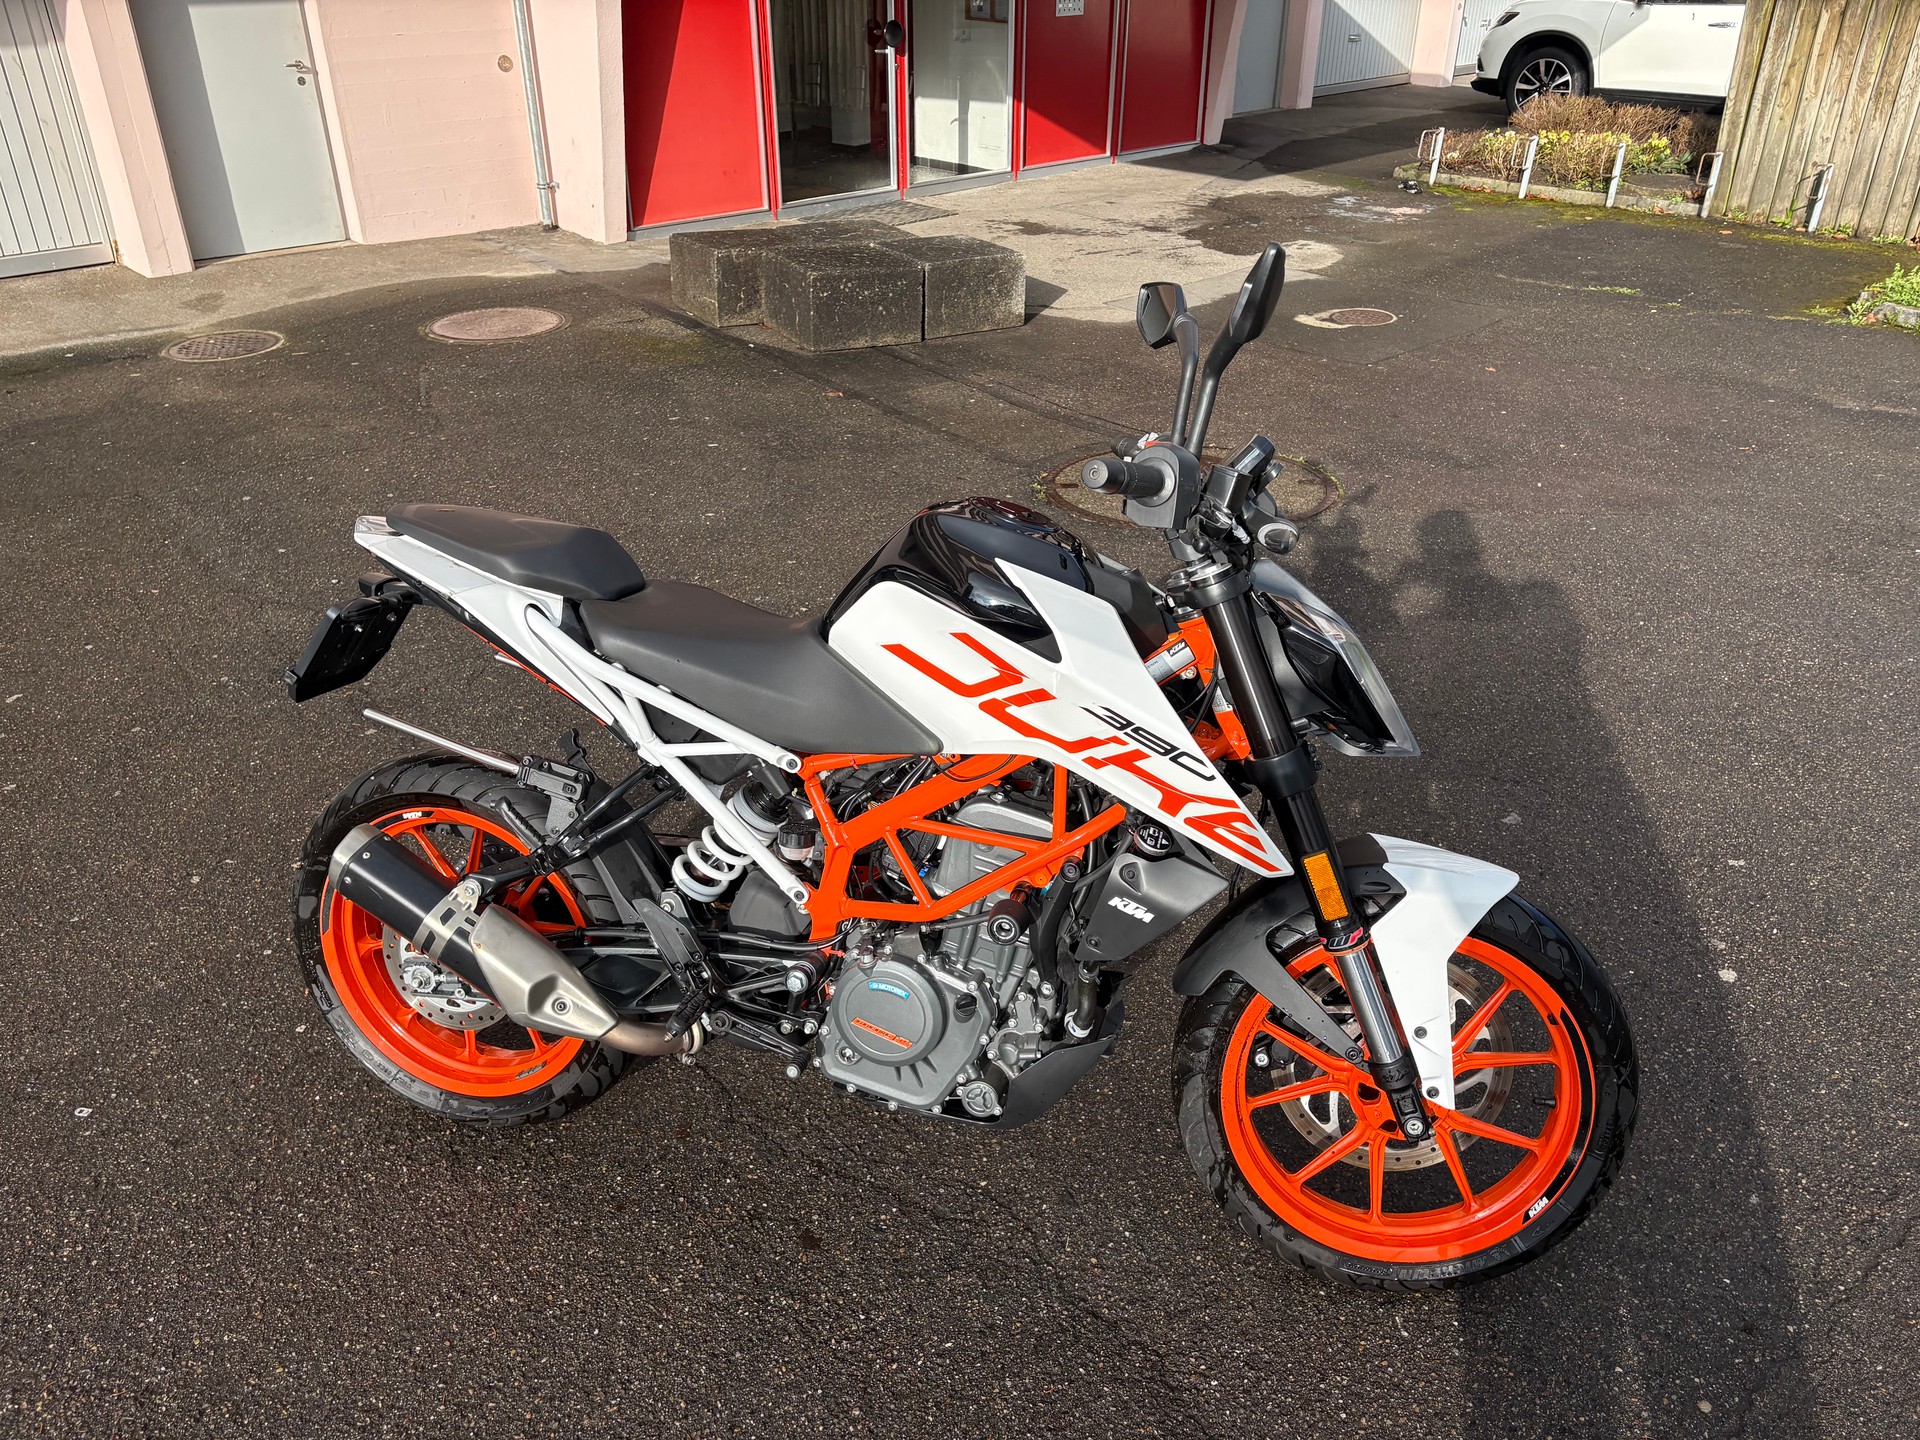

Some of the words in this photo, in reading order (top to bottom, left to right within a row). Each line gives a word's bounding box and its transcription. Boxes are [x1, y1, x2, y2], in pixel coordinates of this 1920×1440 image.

[1169, 641, 1186, 655] KTM
[1080, 704, 1216, 781] 390
[1107, 896, 1155, 923] KTM
[878, 983, 906, 998] MOTOREX
[1528, 1196, 1549, 1218] KTM
